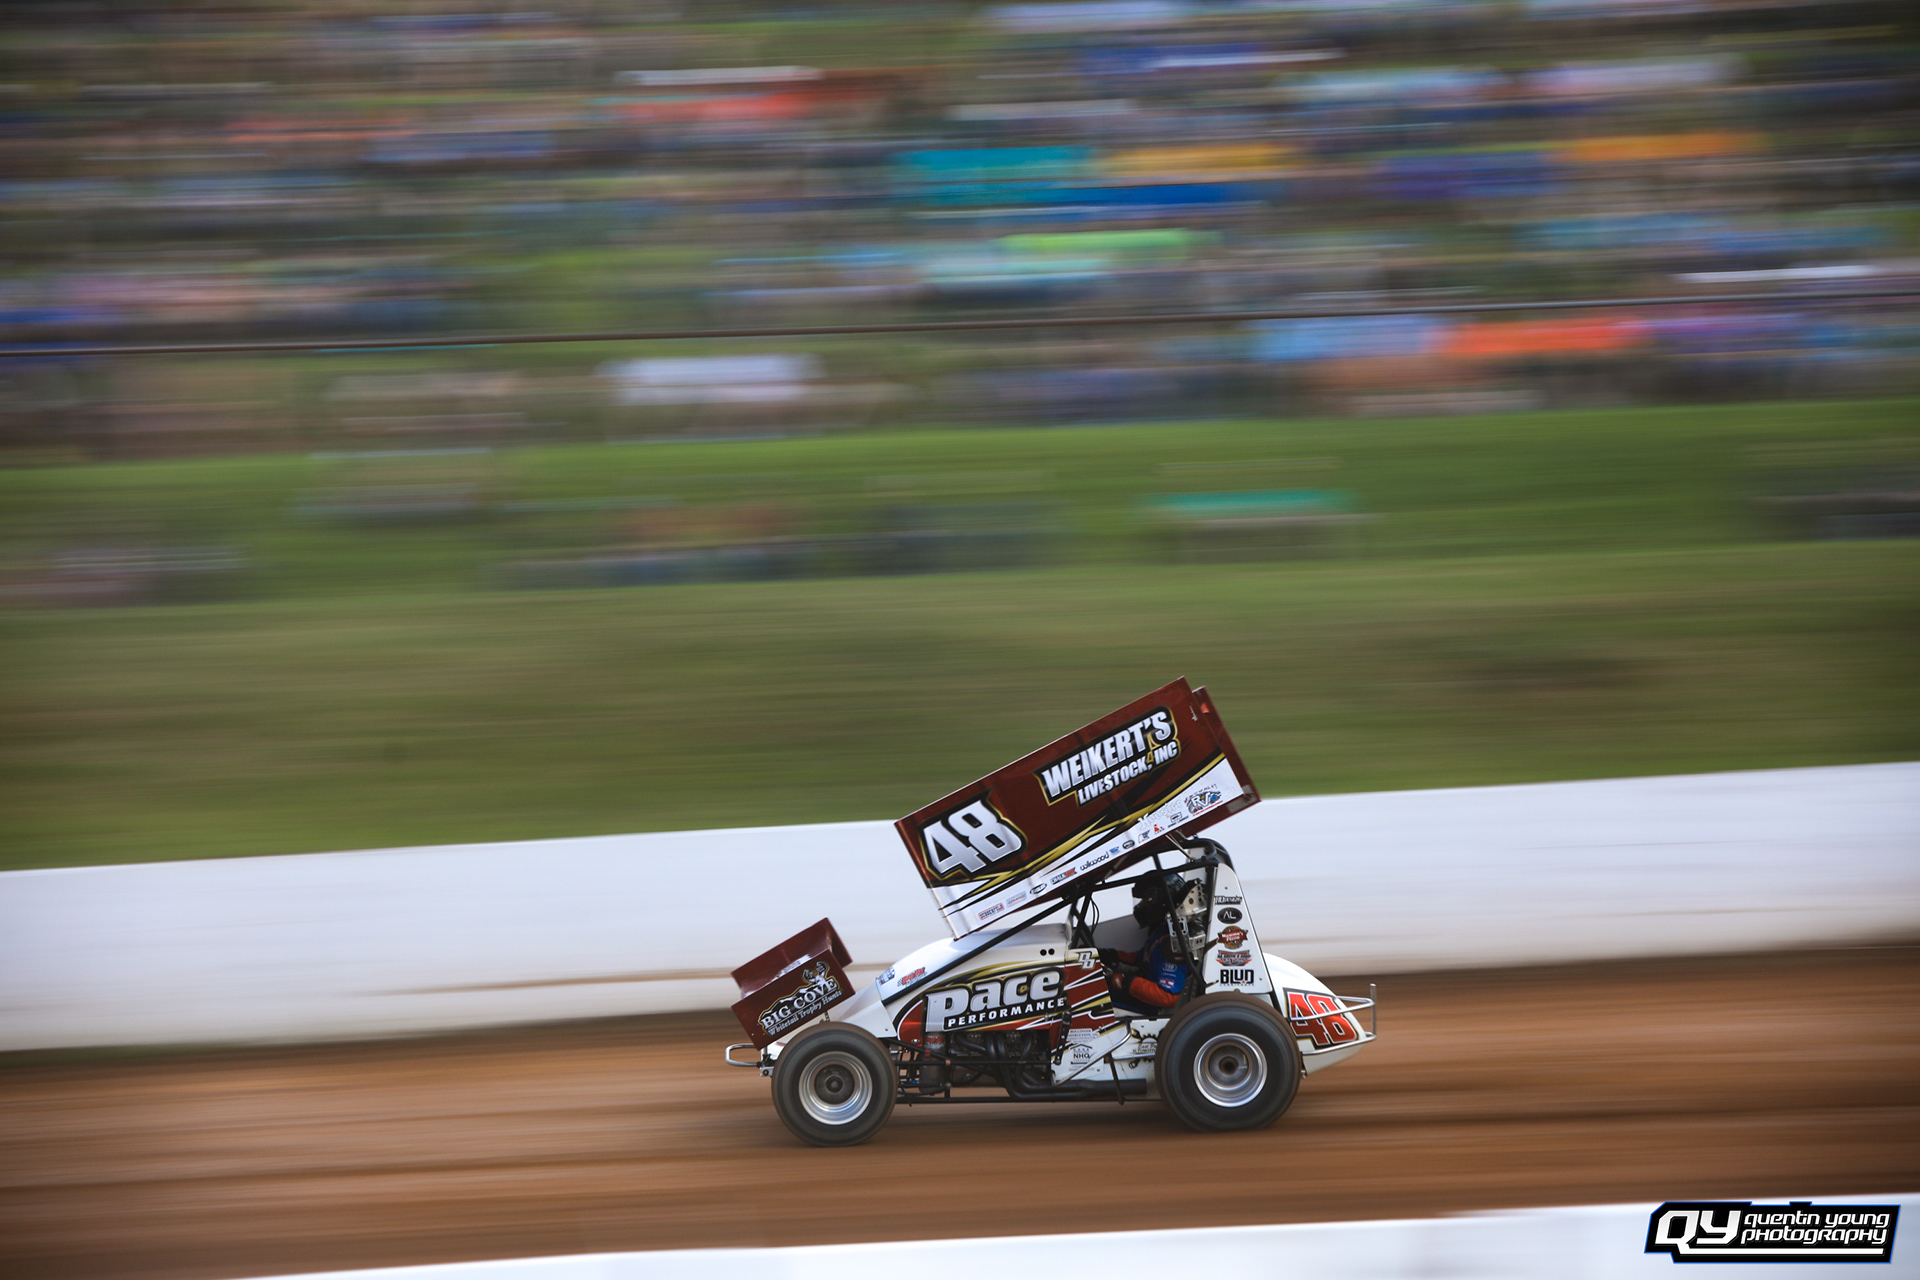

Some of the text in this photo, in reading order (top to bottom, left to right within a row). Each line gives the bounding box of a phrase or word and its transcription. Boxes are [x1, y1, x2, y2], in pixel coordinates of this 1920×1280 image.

[1041, 711, 1172, 798] WEIKERT'S
[1153, 741, 1178, 766] INC
[923, 800, 1022, 873] 48
[761, 978, 838, 1030] BIG COVE
[798, 1002, 822, 1019] Trophy
[821, 990, 842, 1006] Hunts
[948, 999, 1065, 1028] PERFORMANCE
[1288, 992, 1357, 1046] 48
